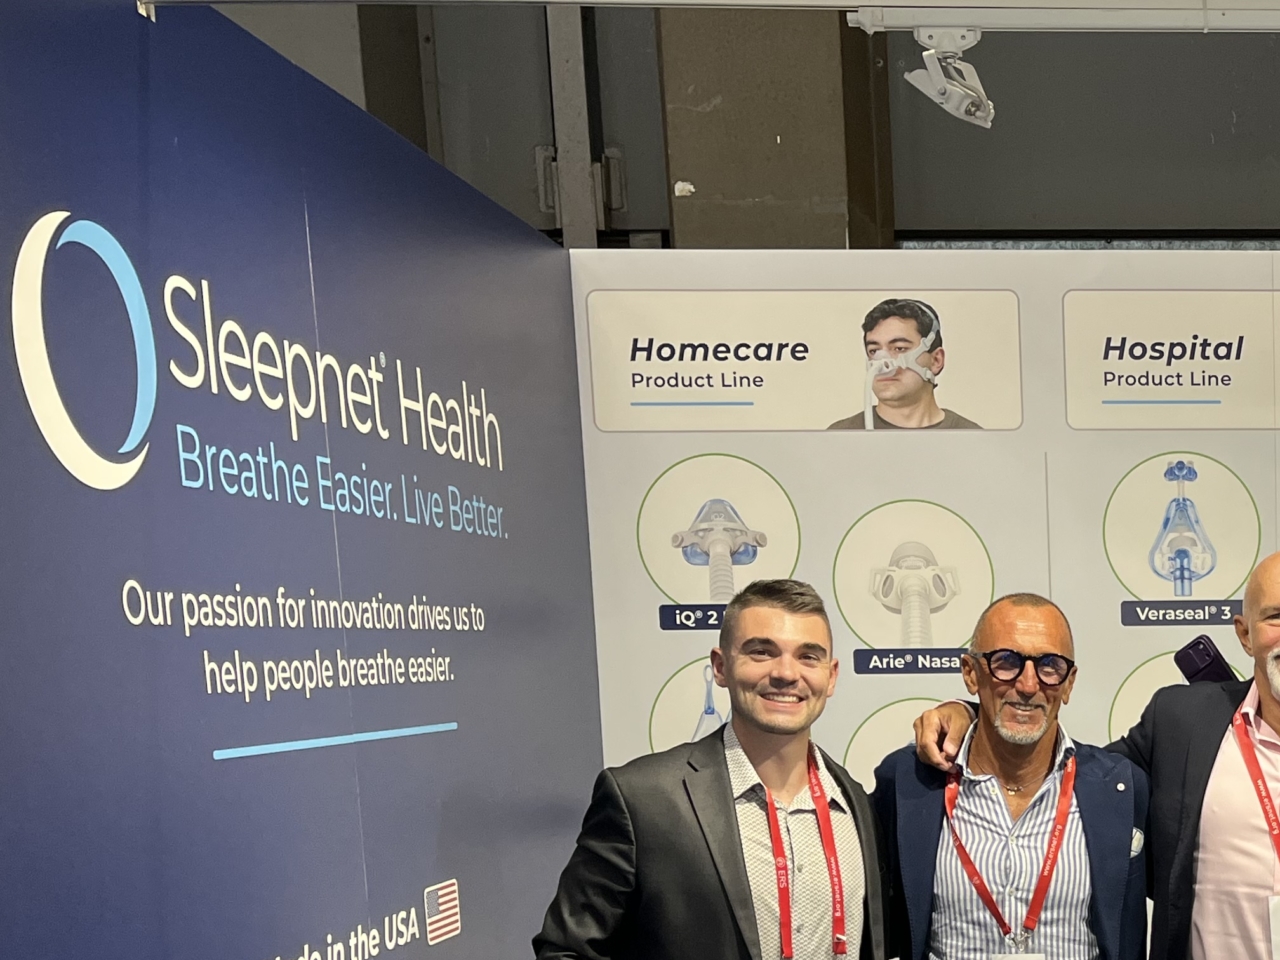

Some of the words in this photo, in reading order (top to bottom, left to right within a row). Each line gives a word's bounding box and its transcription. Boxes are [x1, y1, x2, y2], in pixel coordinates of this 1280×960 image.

[630, 336, 810, 363] Homecare
[1102, 334, 1244, 366] Hospital
[631, 371, 714, 388] Product
[719, 371, 764, 388] Line
[1103, 370, 1184, 387] Product
[1190, 370, 1232, 387] Line
[396, 359, 503, 471] Health
[176, 424, 309, 507] Breathe
[316, 455, 398, 521] Easier.
[401, 474, 444, 530] Live
[447, 485, 509, 540] Better.
[122, 579, 175, 627] Our
[181, 582, 273, 637] passion
[276, 586, 306, 628] for
[309, 588, 405, 631] innovation
[408, 595, 452, 632] drives
[453, 606, 470, 632] us
[470, 602, 485, 633] to
[707, 610, 718, 625] 2
[1221, 606, 1231, 620] 3
[203, 650, 258, 702] help
[263, 649, 334, 701] people
[336, 648, 405, 688] breathe
[408, 647, 455, 682] easier.
[777, 870, 788, 889] ERS
[829, 856, 843, 917] www.ersnet.org
[384, 907, 420, 950] USA
